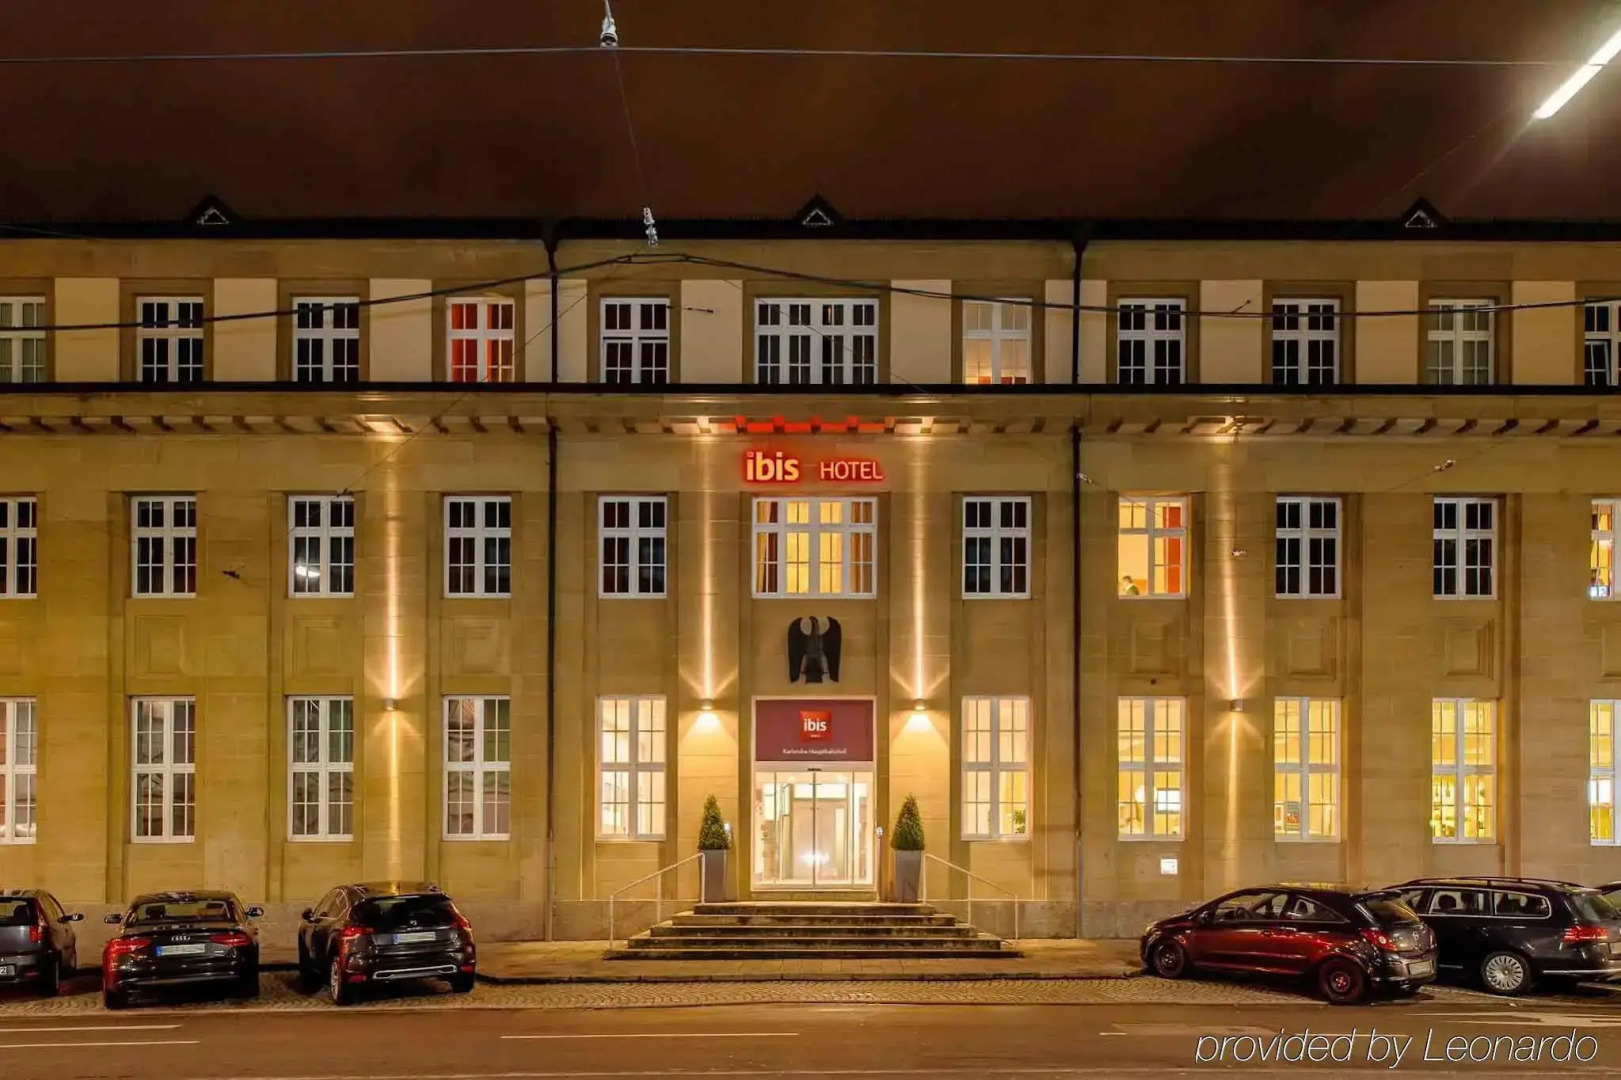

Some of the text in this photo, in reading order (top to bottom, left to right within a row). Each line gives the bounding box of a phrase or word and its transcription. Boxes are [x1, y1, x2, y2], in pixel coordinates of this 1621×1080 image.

[746, 451, 883, 481] ibis HOTEL
[803, 718, 827, 731] ibis
